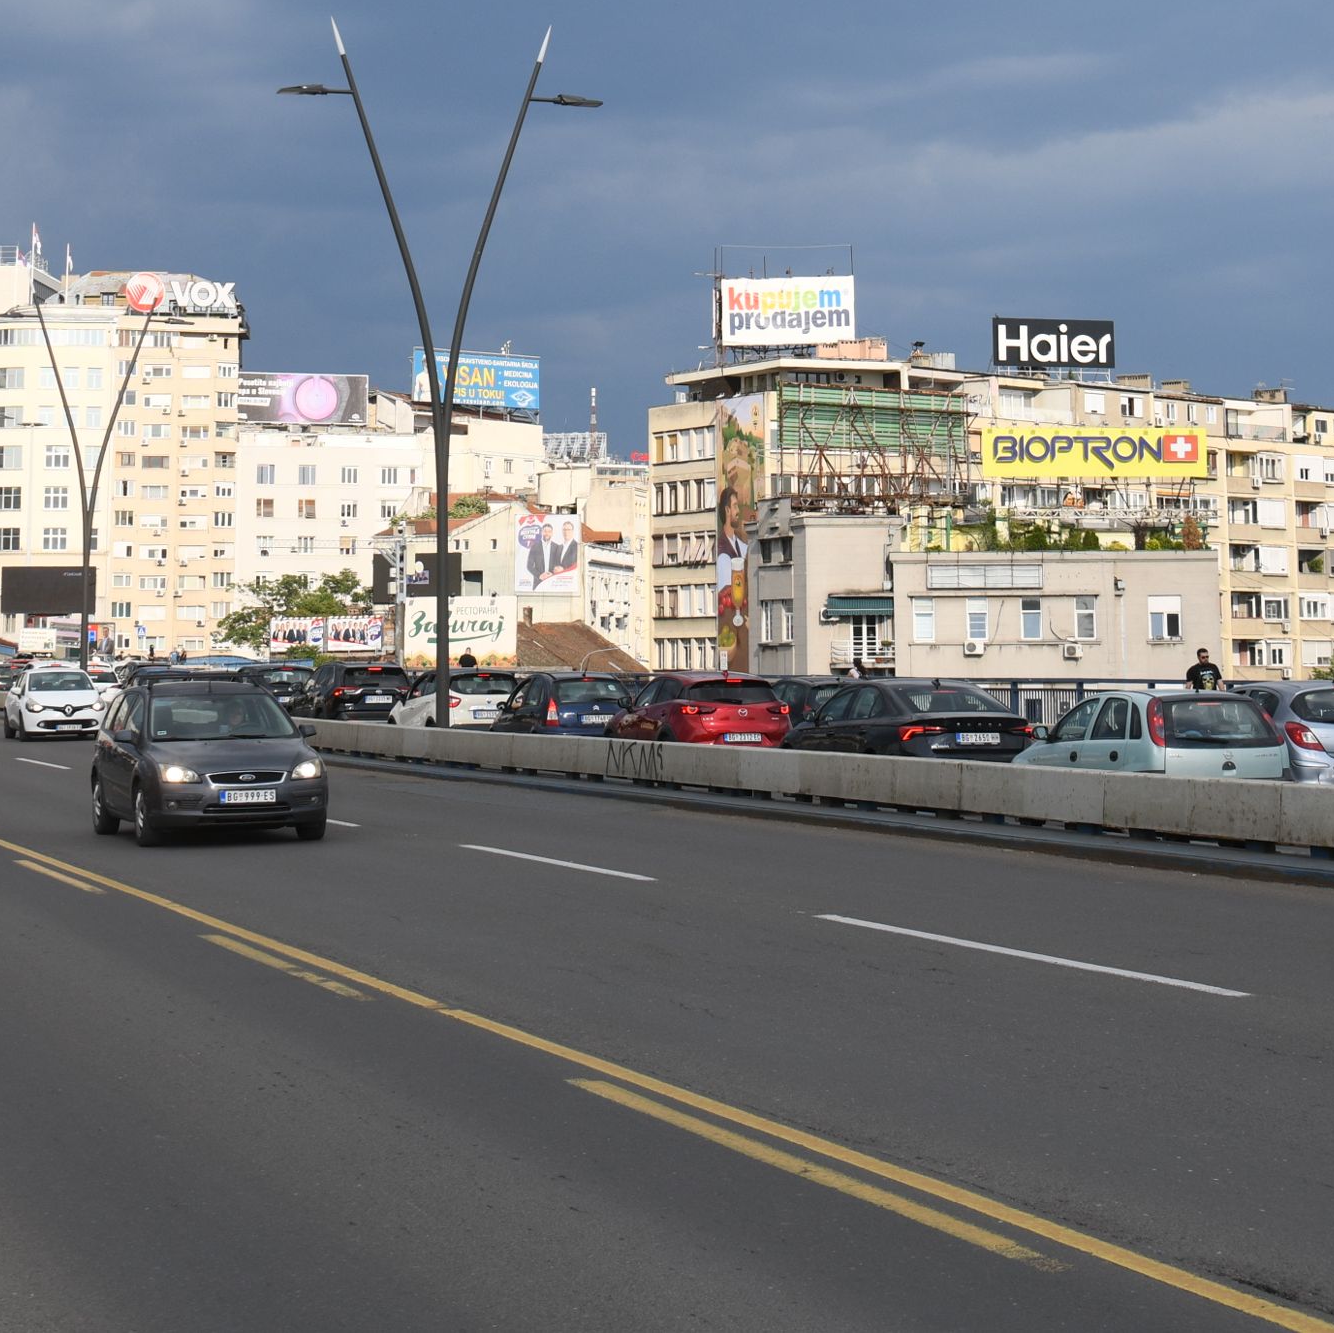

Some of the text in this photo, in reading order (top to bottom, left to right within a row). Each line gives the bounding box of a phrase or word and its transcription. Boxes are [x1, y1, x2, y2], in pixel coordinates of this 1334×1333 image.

[171, 280, 235, 307] VOX
[728, 286, 842, 315] kupujem
[729, 308, 850, 335] prodajem
[997, 323, 1111, 364] Haier
[503, 369, 533, 378] MEDICINA
[503, 379, 539, 388] EKOLOGIJA
[477, 388, 505, 400] TOKU!
[993, 435, 1162, 470] BIOPTRON
[456, 606, 498, 616] РЕСТОРАНИ
[227, 792, 238, 801] BG
